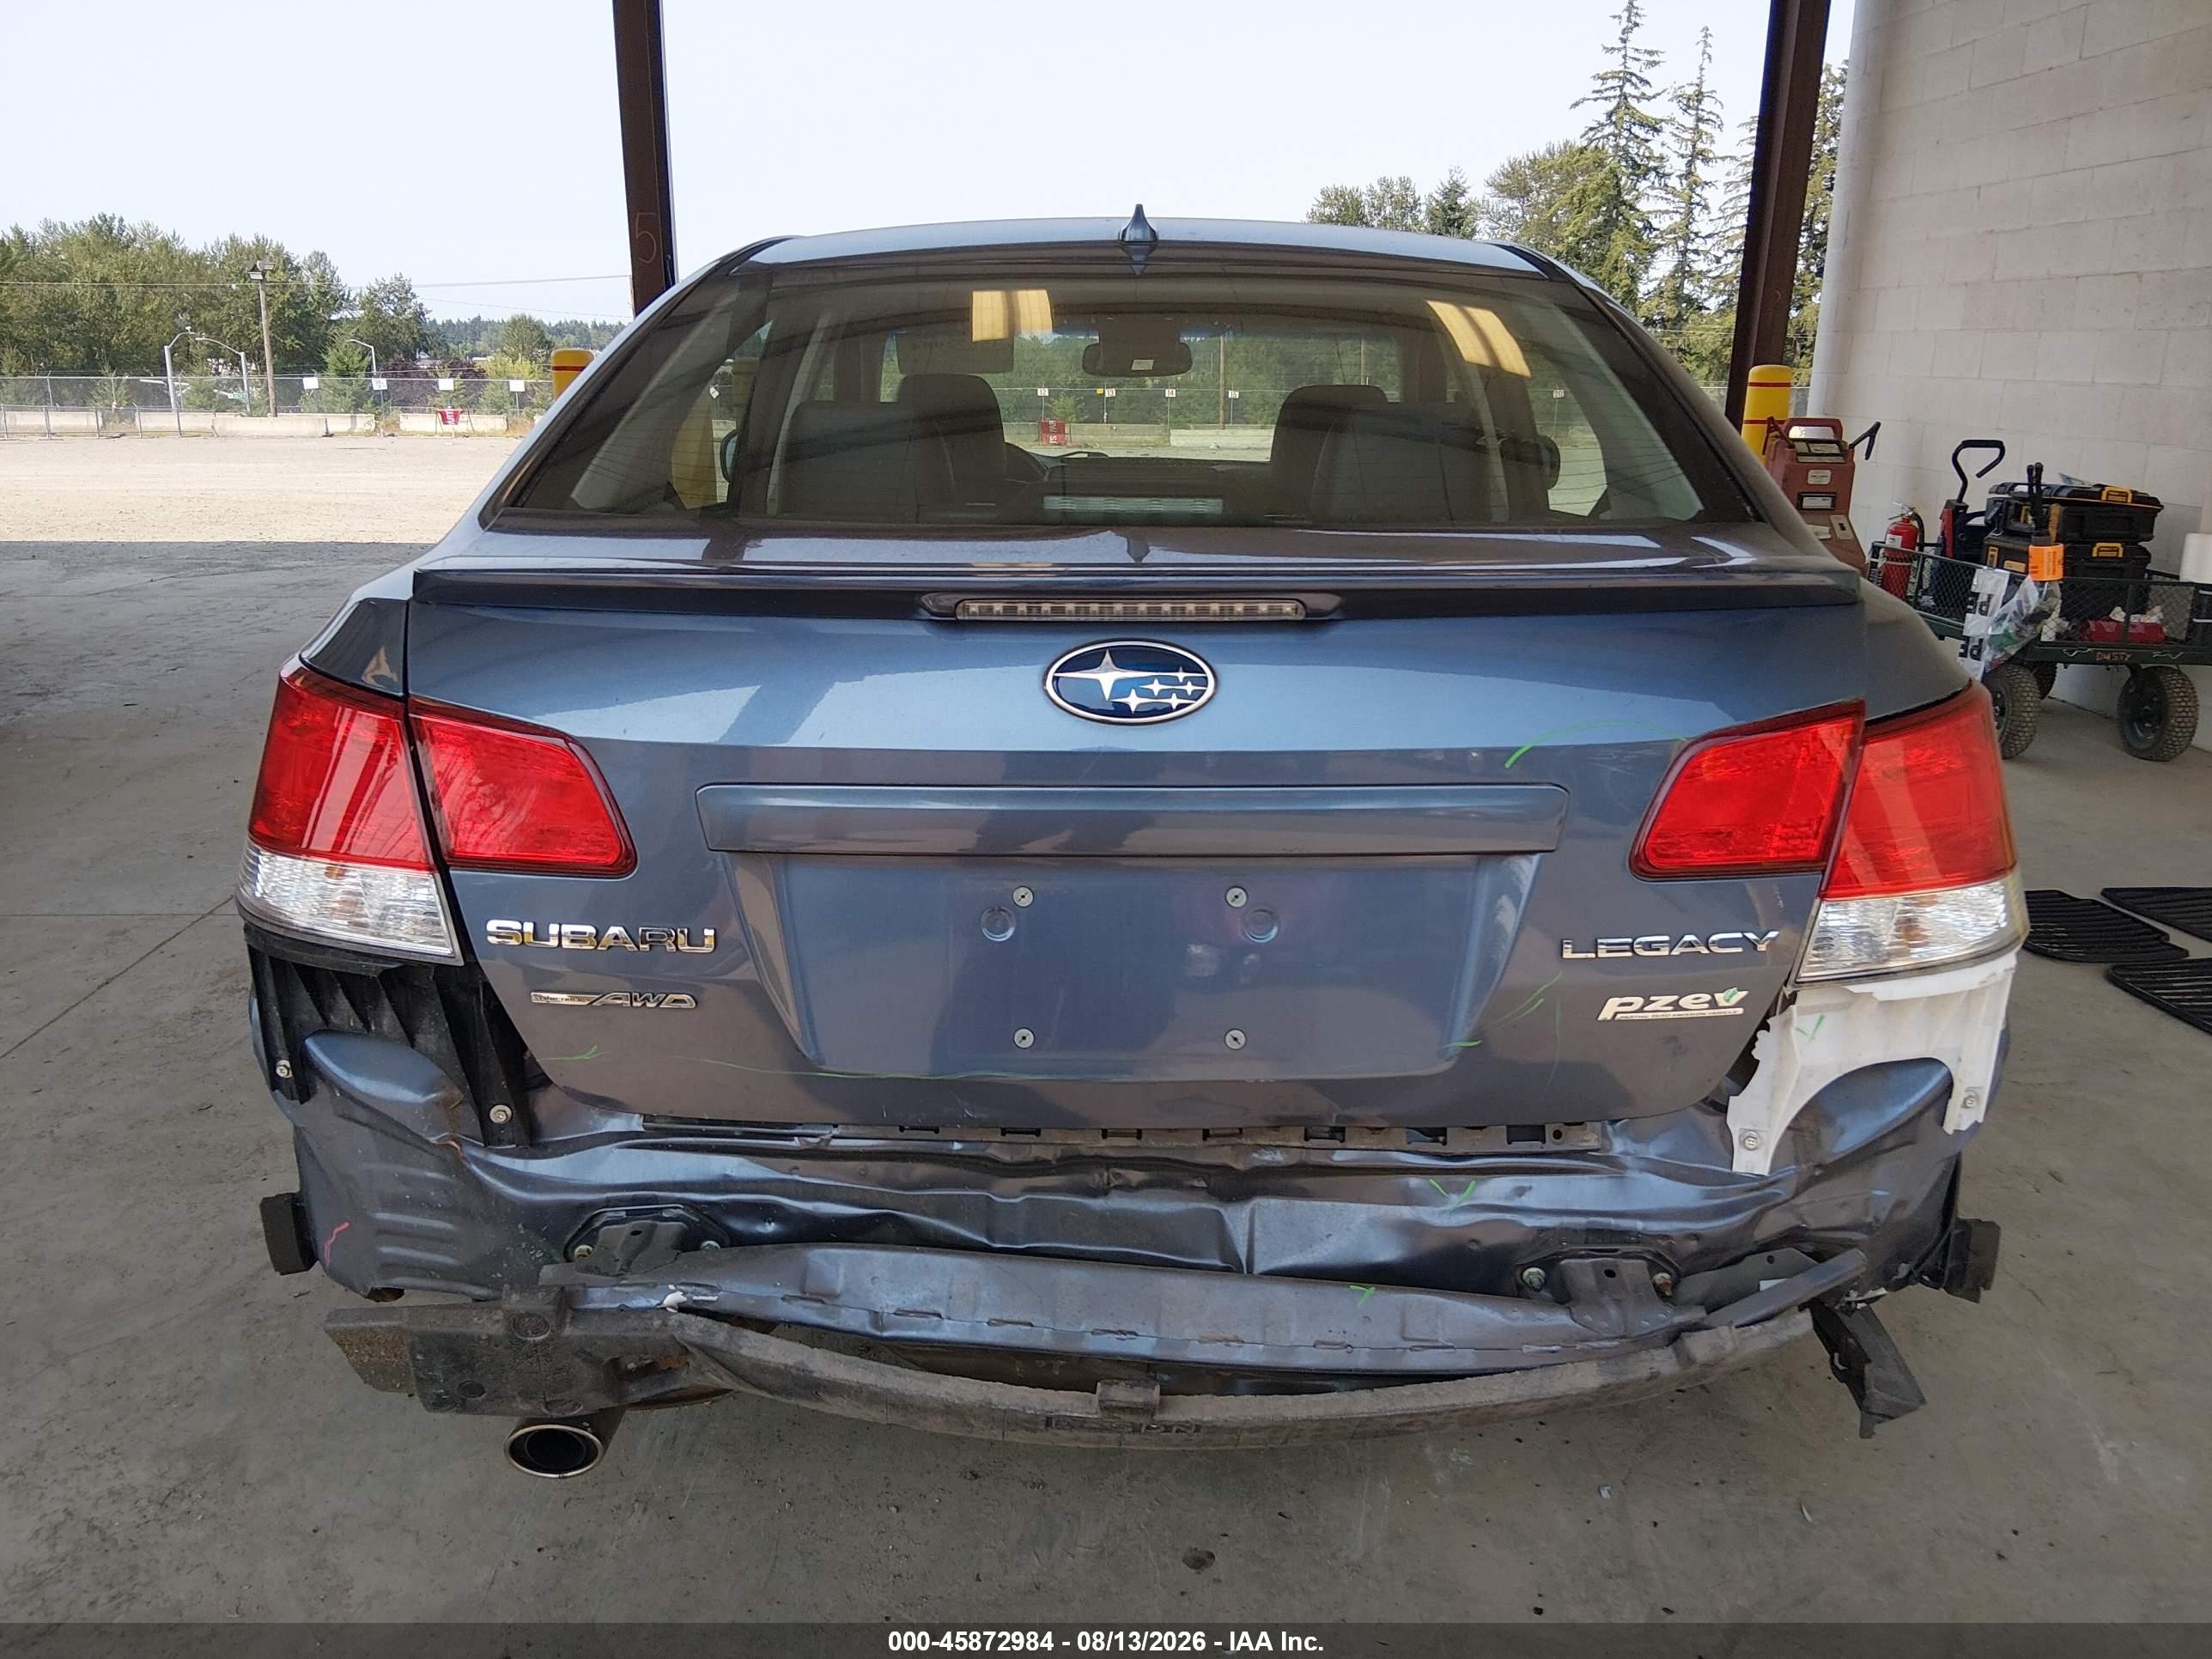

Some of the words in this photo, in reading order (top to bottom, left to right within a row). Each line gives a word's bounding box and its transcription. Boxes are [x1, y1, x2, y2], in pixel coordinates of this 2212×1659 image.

[486, 920, 715, 953] SUBARU
[1562, 931, 1780, 959] LEGACY
[592, 992, 696, 1009] AWD
